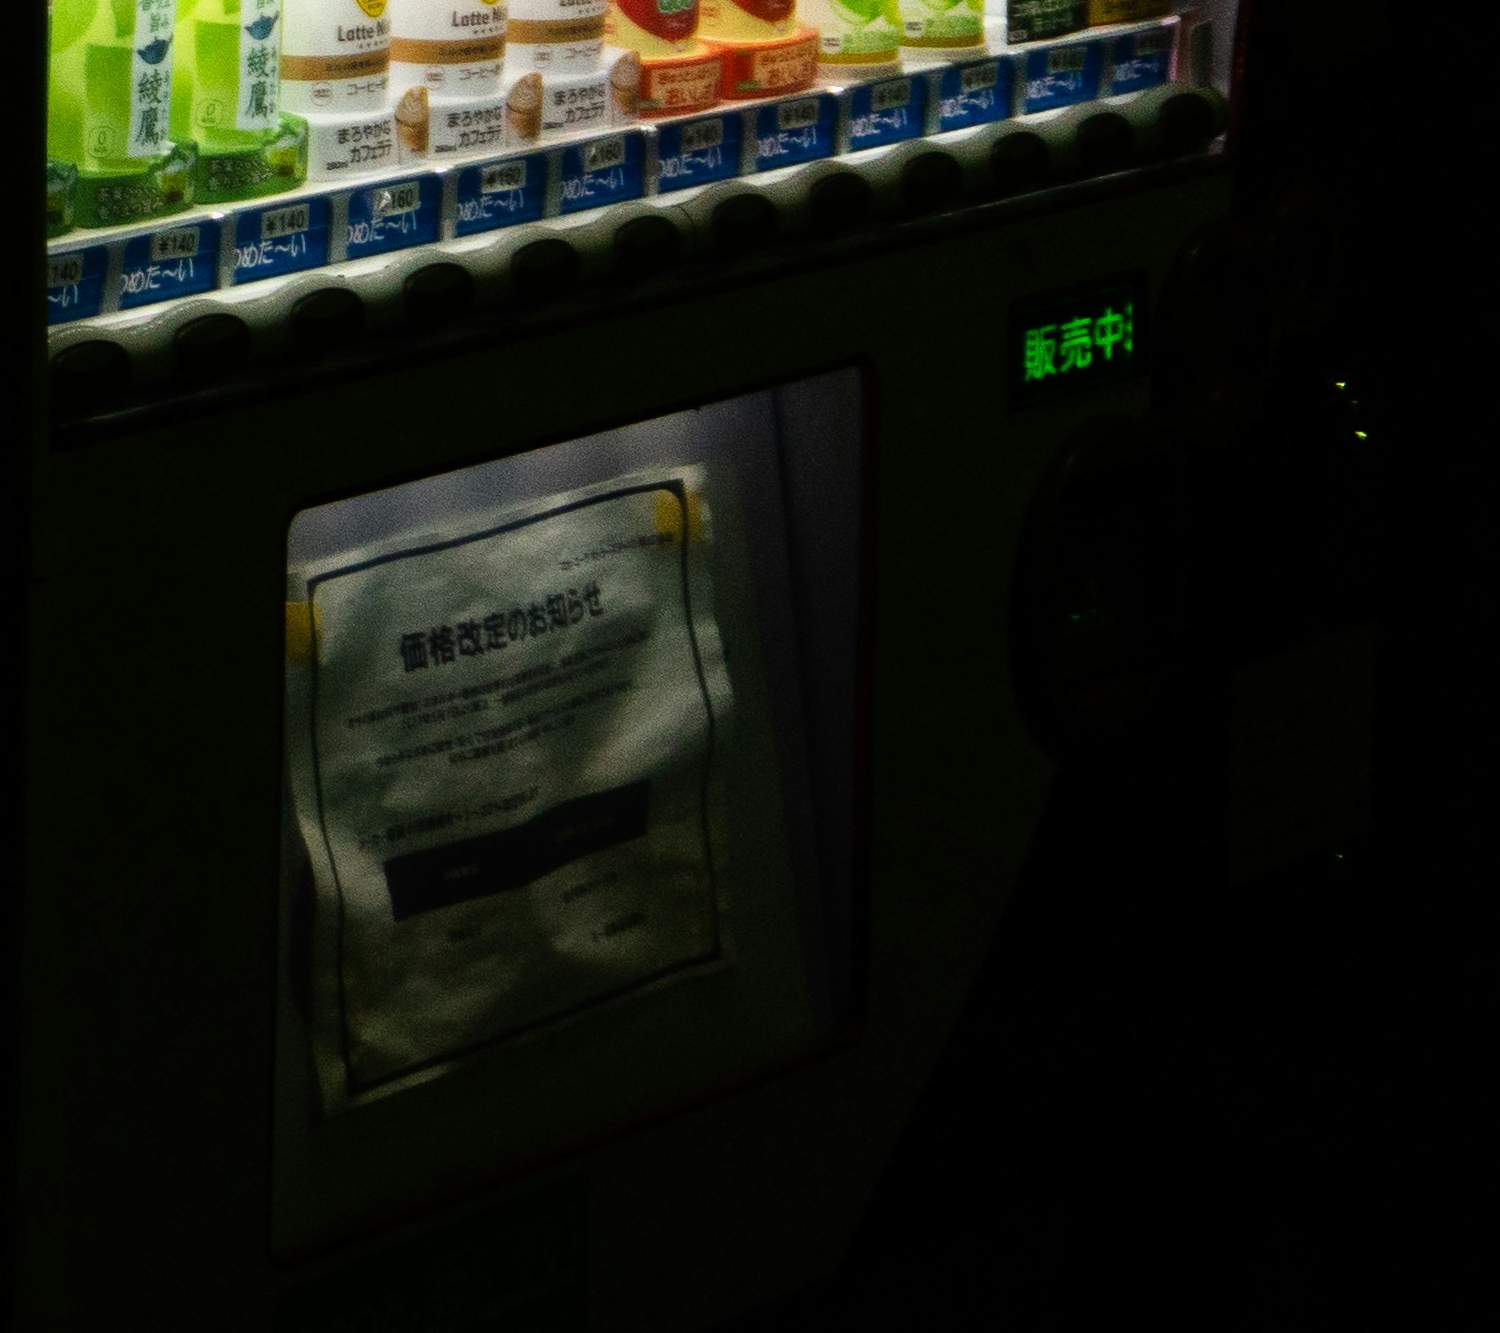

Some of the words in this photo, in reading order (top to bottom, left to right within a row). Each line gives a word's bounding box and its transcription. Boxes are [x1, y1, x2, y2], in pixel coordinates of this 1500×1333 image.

[337, 23, 375, 42] Latte
[452, 8, 490, 28] Latte
[1019, 303, 1120, 383] 販売中
[399, 580, 605, 673] 価格改定のお知らせ
